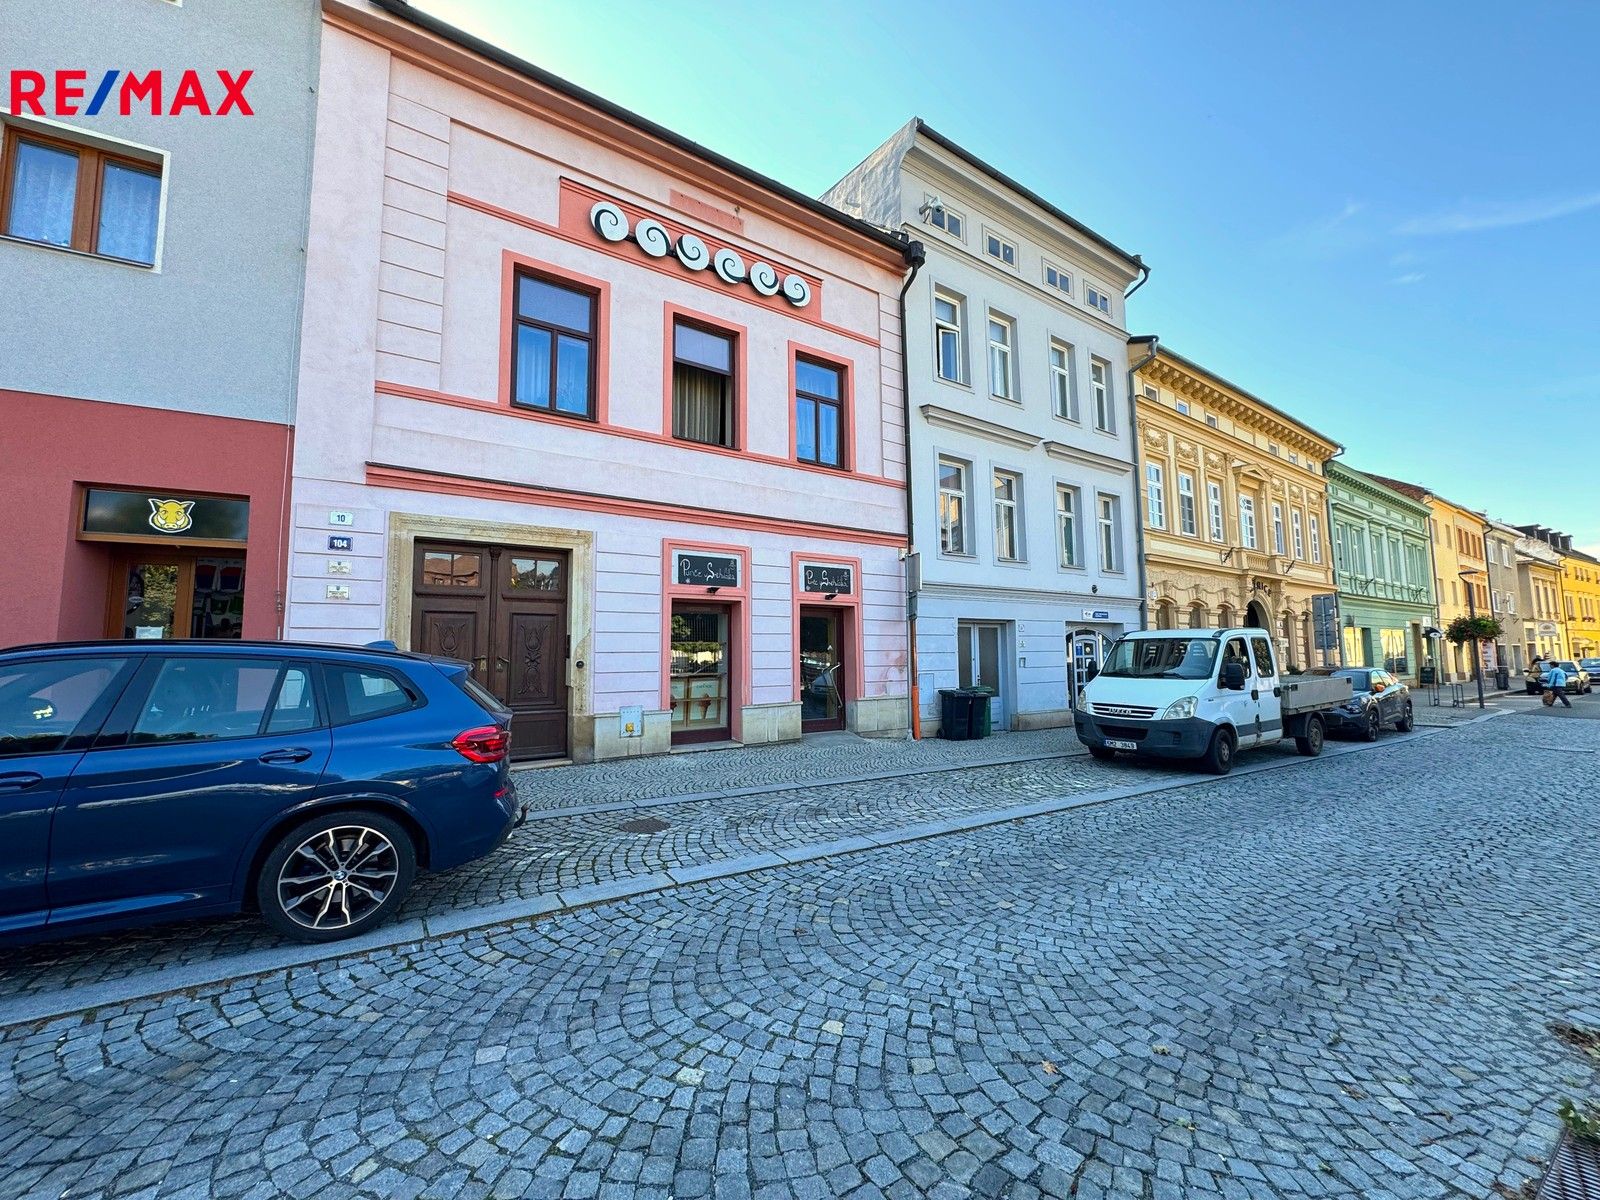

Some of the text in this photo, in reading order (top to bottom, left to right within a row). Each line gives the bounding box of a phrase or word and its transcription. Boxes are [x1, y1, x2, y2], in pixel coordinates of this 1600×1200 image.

[337, 514, 346, 523] 10
[333, 539, 348, 548] 104
[1108, 707, 1132, 716] IVECO
